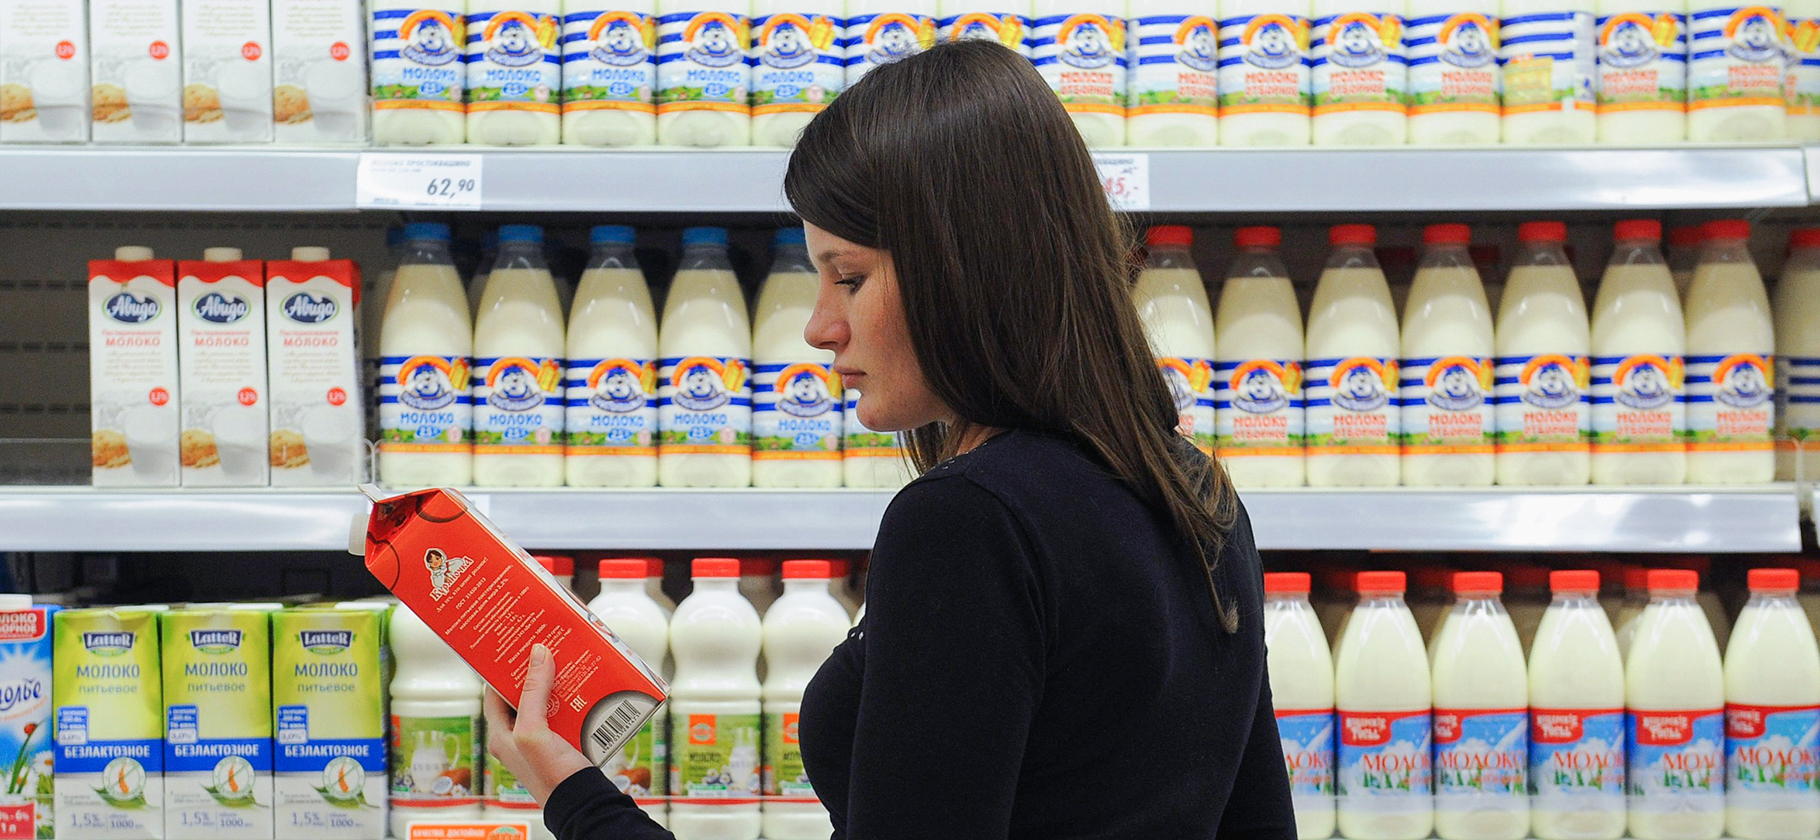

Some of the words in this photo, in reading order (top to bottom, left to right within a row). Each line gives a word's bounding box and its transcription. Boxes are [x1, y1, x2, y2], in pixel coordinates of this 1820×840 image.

[403, 67, 456, 82] МОЛОКО
[486, 69, 542, 83] МОЛОКО
[592, 68, 646, 83] МОЛОКО
[687, 69, 740, 83] МОЛОКО
[761, 70, 815, 84] МОЛОКО
[427, 178, 476, 199] 62,90
[105, 336, 161, 347] МОЛОКО
[194, 336, 249, 347] МОЛОКО
[283, 336, 339, 347] МОЛОКО
[401, 412, 455, 424] МОЛОКО
[489, 414, 543, 426] МОЛОКО
[591, 415, 645, 427] МОЛОКО
[674, 413, 728, 425] МОЛОКО
[778, 419, 832, 431] МОЛОКО
[454, 597, 466, 609] ГОСТ
[458, 609, 479, 630] массовая
[477, 598, 489, 611] доля
[486, 588, 499, 600] жира
[444, 617, 461, 635] Молоко
[459, 599, 479, 619] питьевое
[507, 650, 520, 664] Масса
[518, 634, 537, 653] продукта
[76, 663, 141, 678] МОЛОКО
[184, 662, 248, 677] МОЛОКО
[294, 662, 358, 677] МОЛОКО
[78, 684, 138, 694] питьевое
[187, 683, 246, 693] питьевое
[297, 683, 356, 693] питьевое
[64, 744, 151, 759] БЕЗЛАКТОЗНОЕ
[174, 744, 260, 757] БЕЗЛАКТОЗНОЕ
[284, 744, 370, 758] БЕЗЛАКТОЗНОЕ
